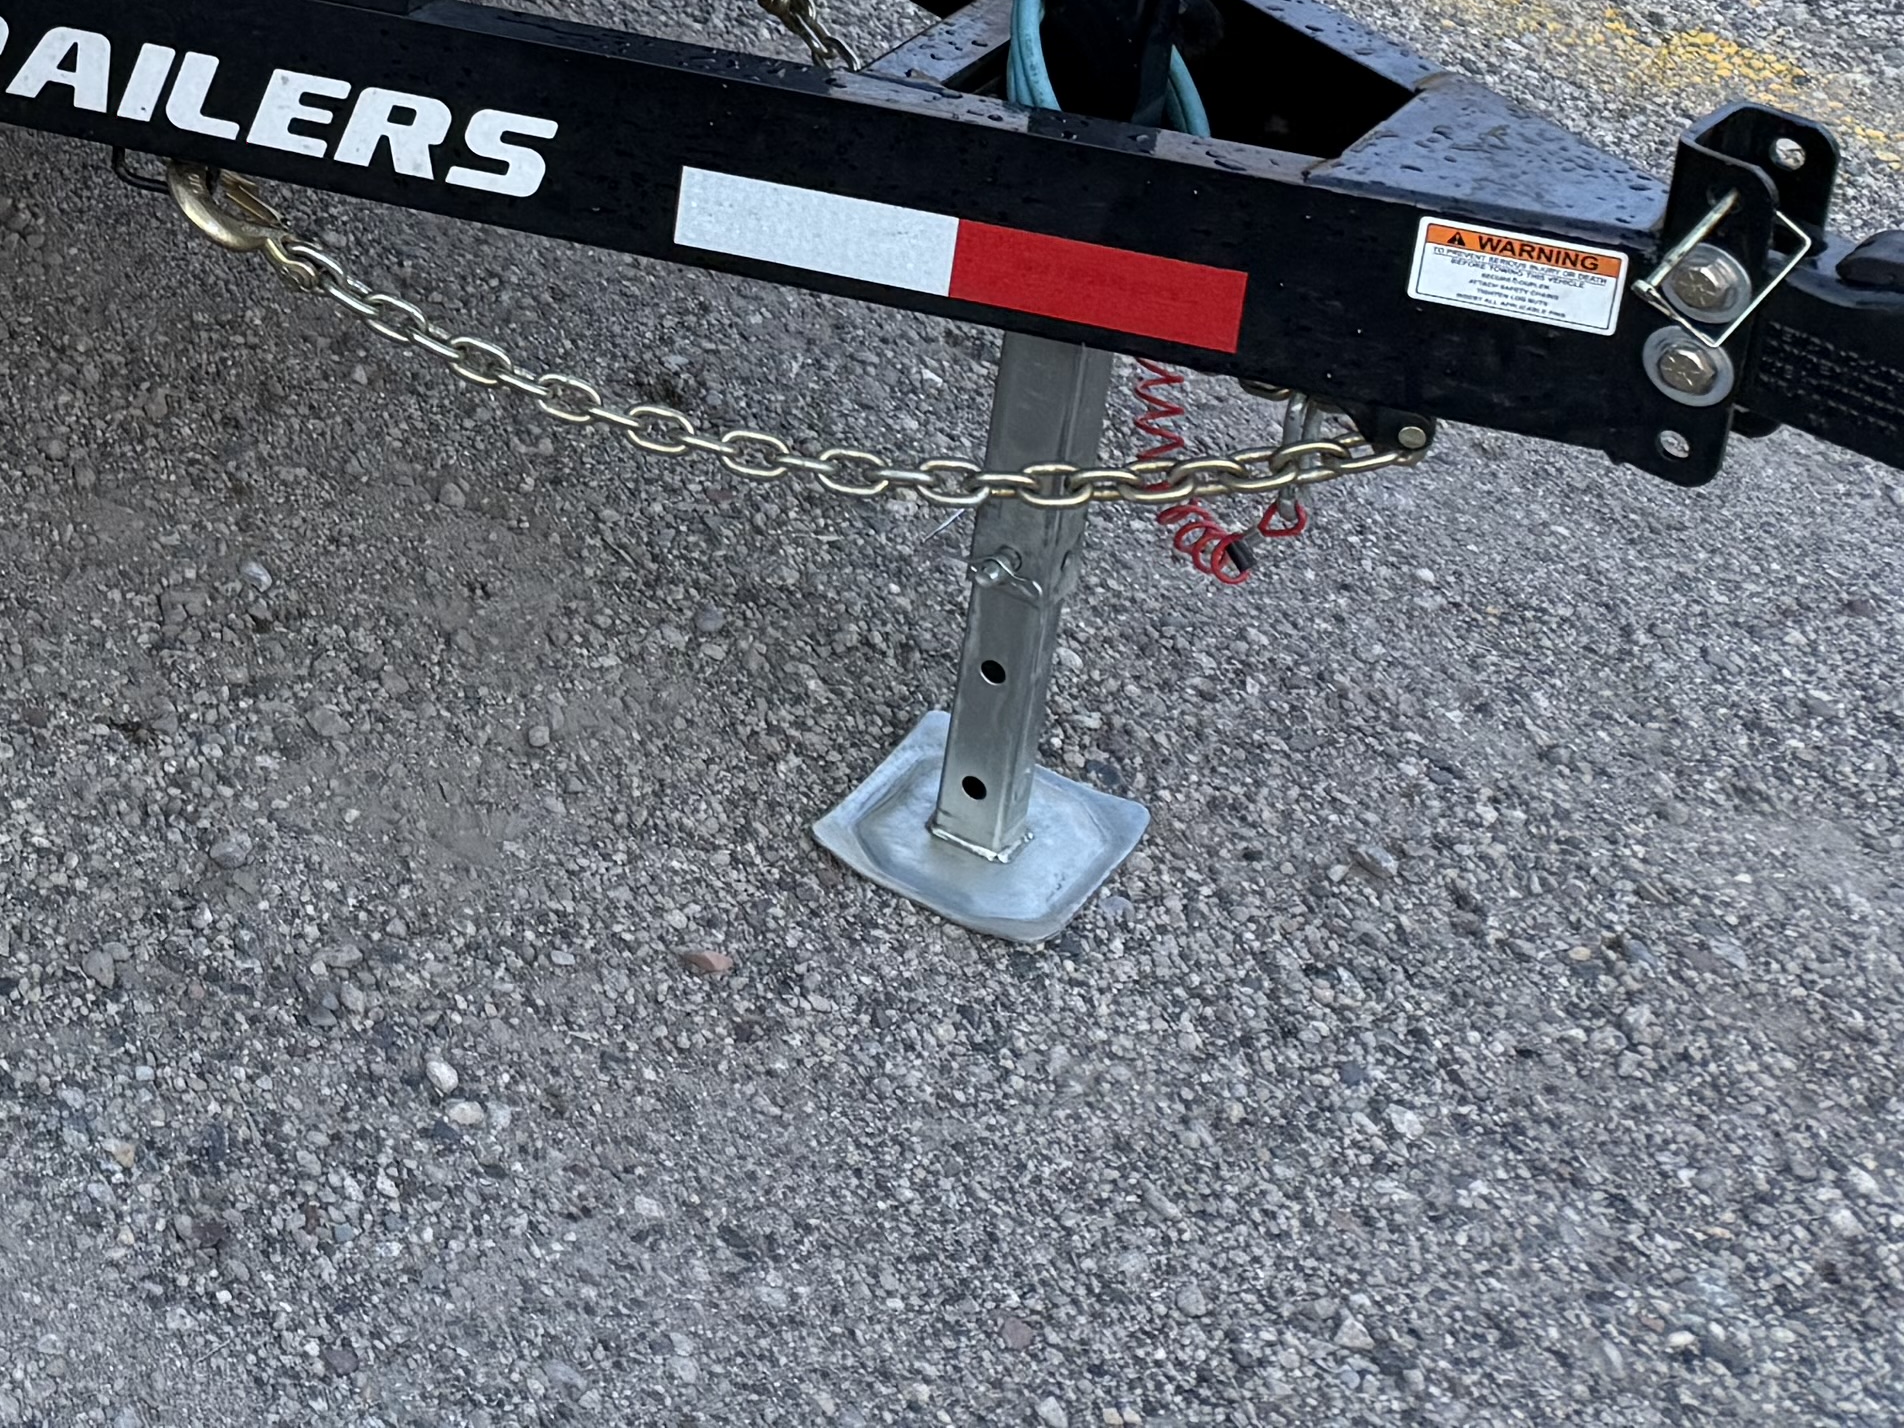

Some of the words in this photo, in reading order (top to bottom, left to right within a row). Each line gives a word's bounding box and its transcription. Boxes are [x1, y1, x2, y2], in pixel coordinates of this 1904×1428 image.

[1433, 246, 1445, 254] TO
[1446, 249, 1487, 261] PREVENT
[1488, 256, 1527, 269] SERIOUS
[1562, 270, 1576, 278] OR
[1577, 273, 1607, 284] DEATH
[1478, 235, 1599, 271] WARNING
[1450, 257, 1486, 270] BEFORE
[1489, 265, 1523, 277] TOWING
[1526, 272, 1545, 281] THIS
[1548, 277, 1585, 289] VEHICLE
